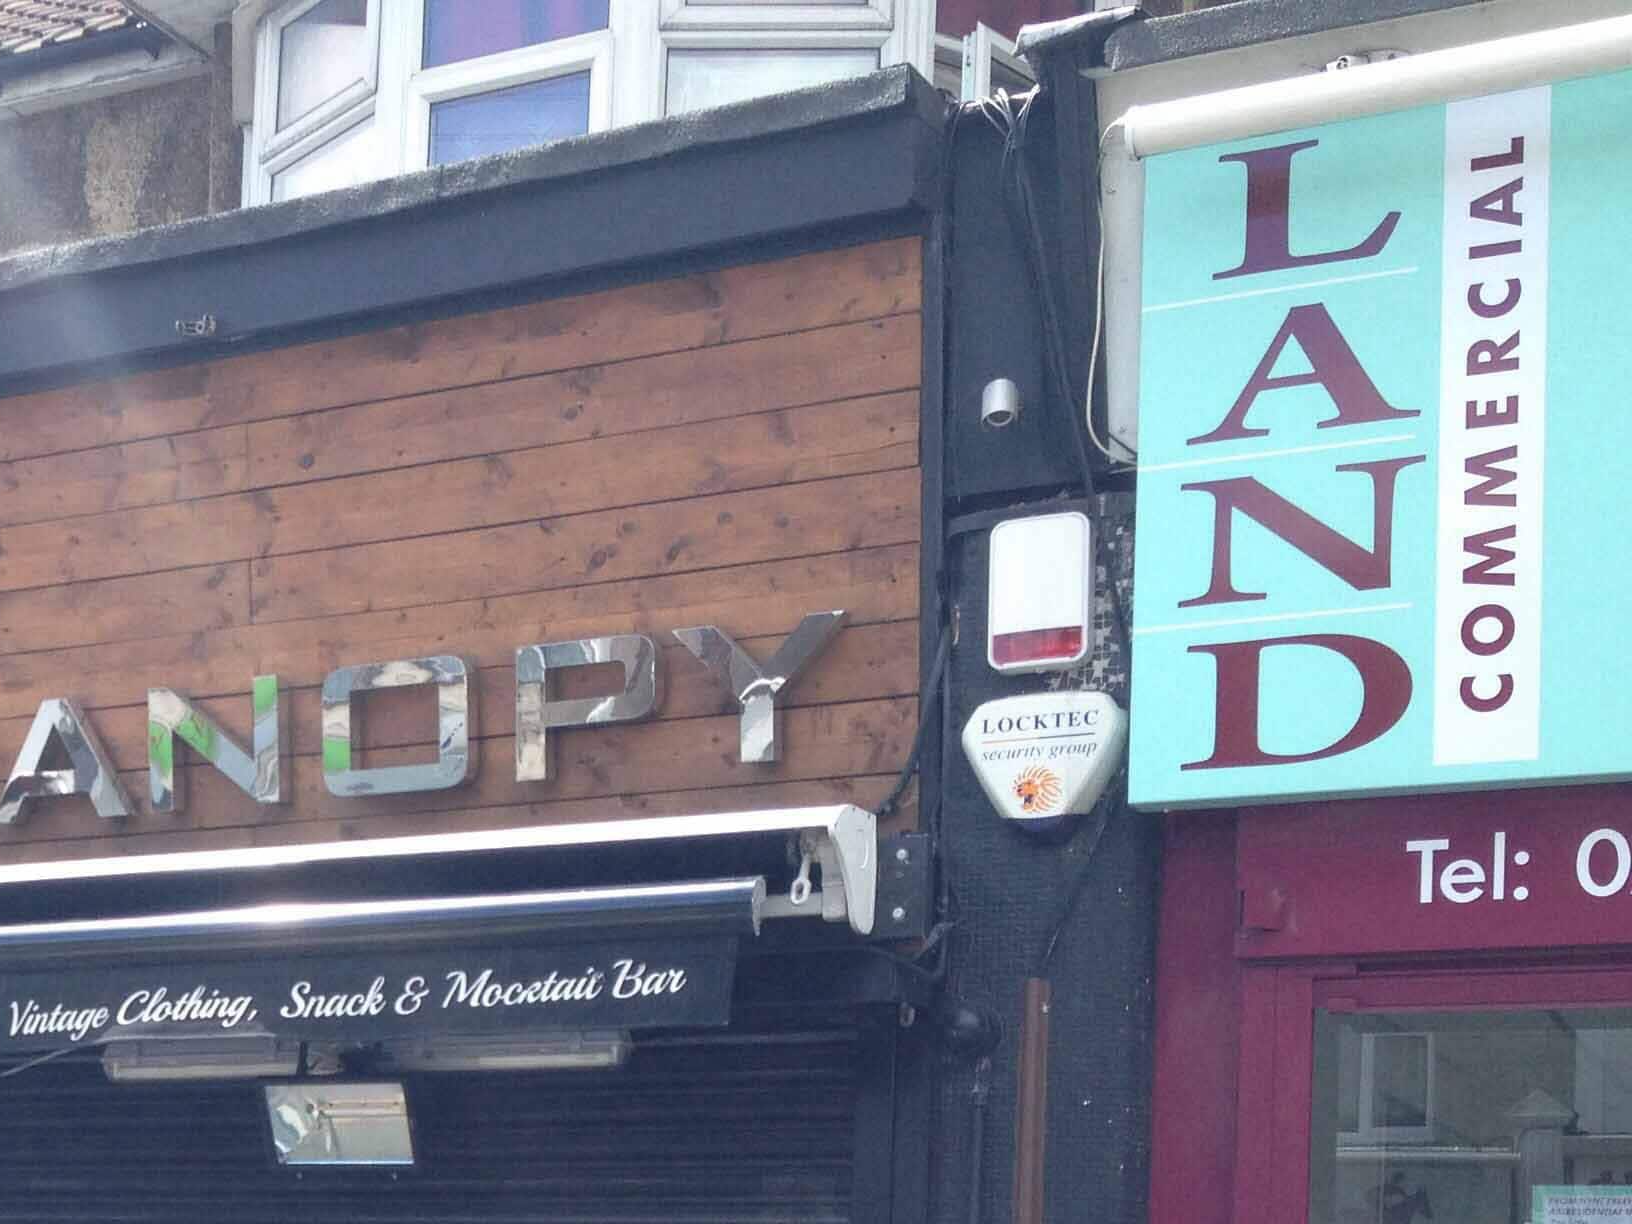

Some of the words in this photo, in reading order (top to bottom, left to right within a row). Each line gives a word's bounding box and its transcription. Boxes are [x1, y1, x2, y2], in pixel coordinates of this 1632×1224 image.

[1178, 139, 1427, 772] LAND
[1459, 135, 1525, 713] COMMERCIAL
[980, 743, 1045, 761] security
[1047, 741, 1098, 760] group
[981, 709, 1099, 735] LOCKTEC
[1406, 831, 1531, 904] Tel:
[8, 999, 110, 1042] Vintage
[116, 985, 257, 1028] Clothing,
[279, 975, 386, 1018] Snack
[394, 974, 430, 1016] &
[612, 957, 688, 1000] Bar
